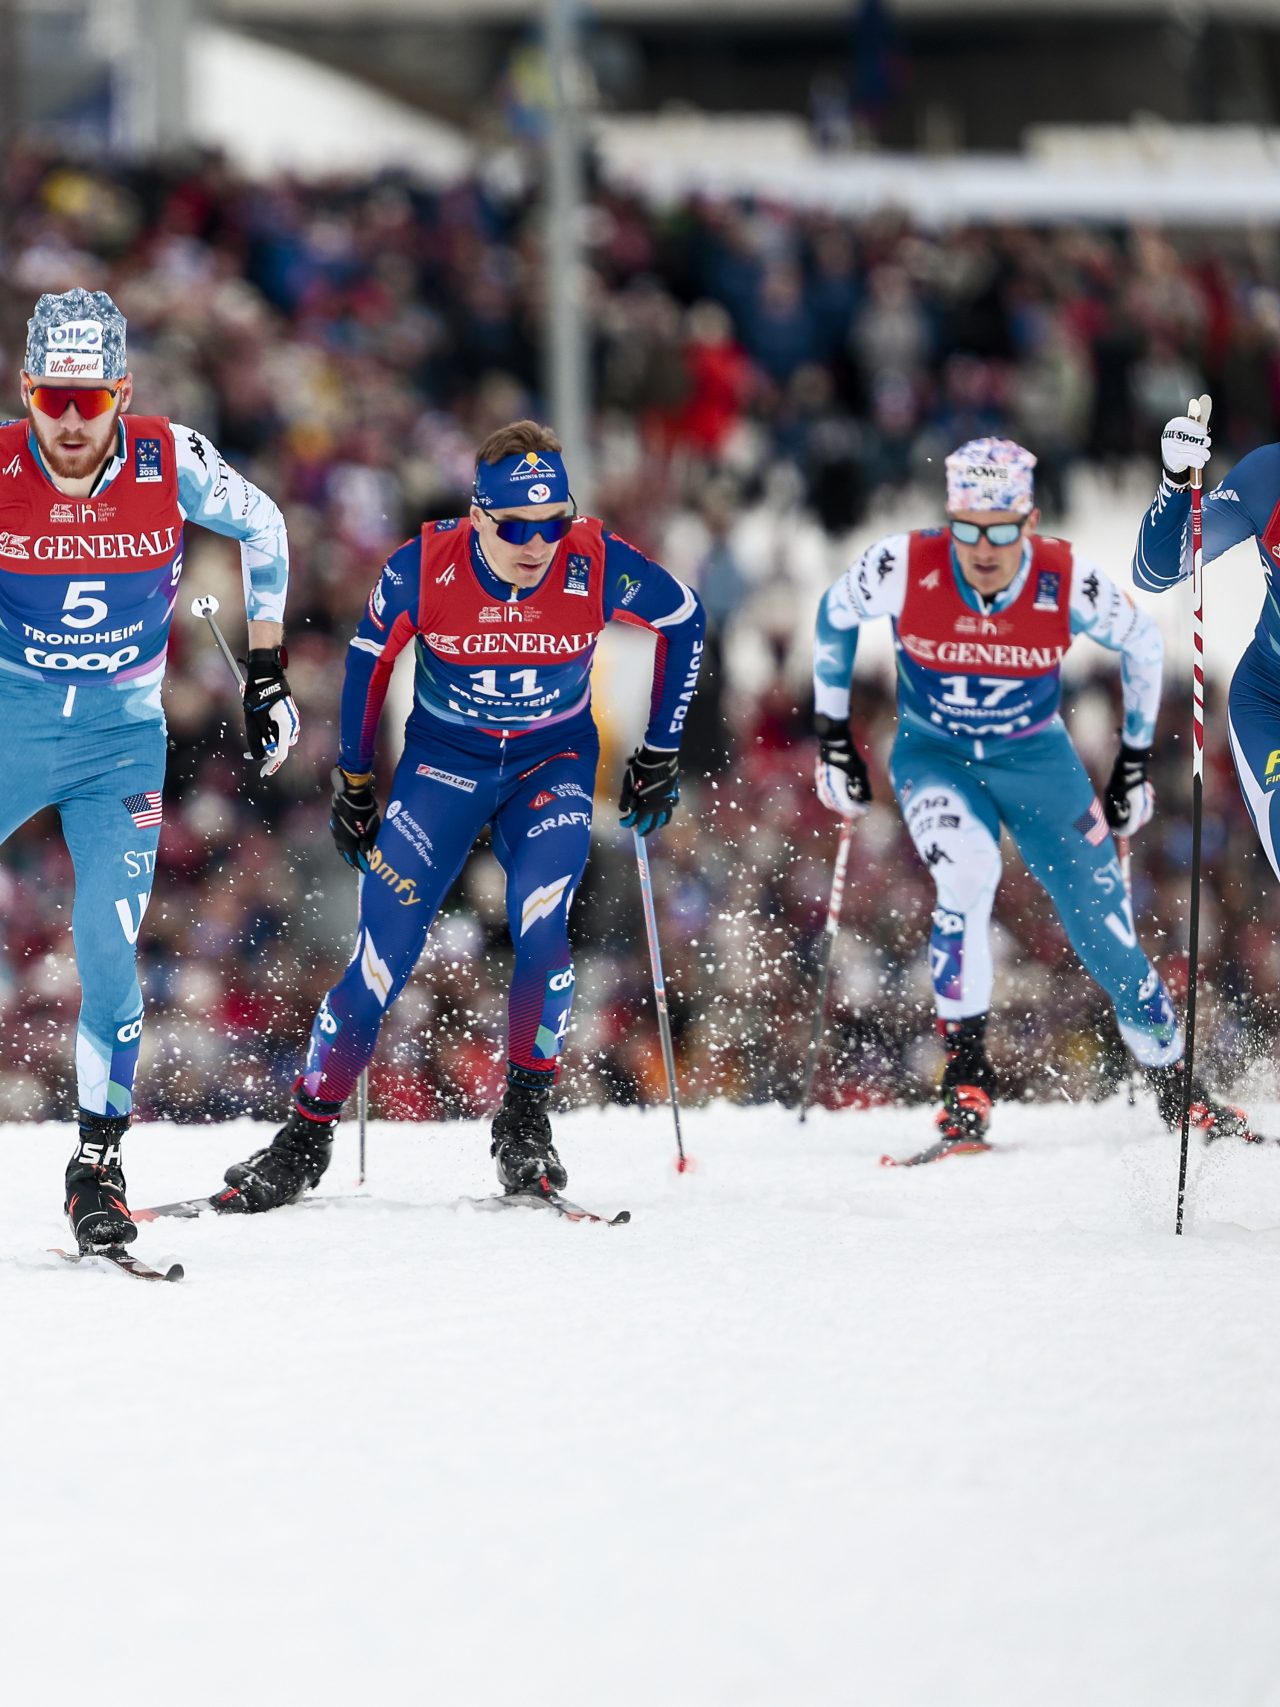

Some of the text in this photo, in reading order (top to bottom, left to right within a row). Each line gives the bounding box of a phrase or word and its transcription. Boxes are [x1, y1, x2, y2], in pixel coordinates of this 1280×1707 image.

[49, 358, 99, 376] Untapped
[33, 526, 175, 560] GENERALI
[61, 580, 109, 629] 5
[22, 620, 144, 645] TRONDHEIM
[462, 631, 597, 655] GENERALI
[23, 645, 140, 674] coop
[937, 641, 1064, 669] GENERALI
[469, 669, 544, 698] 11
[668, 639, 704, 734] FRANCE
[940, 675, 1025, 708] 17
[398, 810, 434, 851] Auvergne-
[526, 812, 587, 838] CRAFT
[391, 816, 434, 867] Rhône-Alpes
